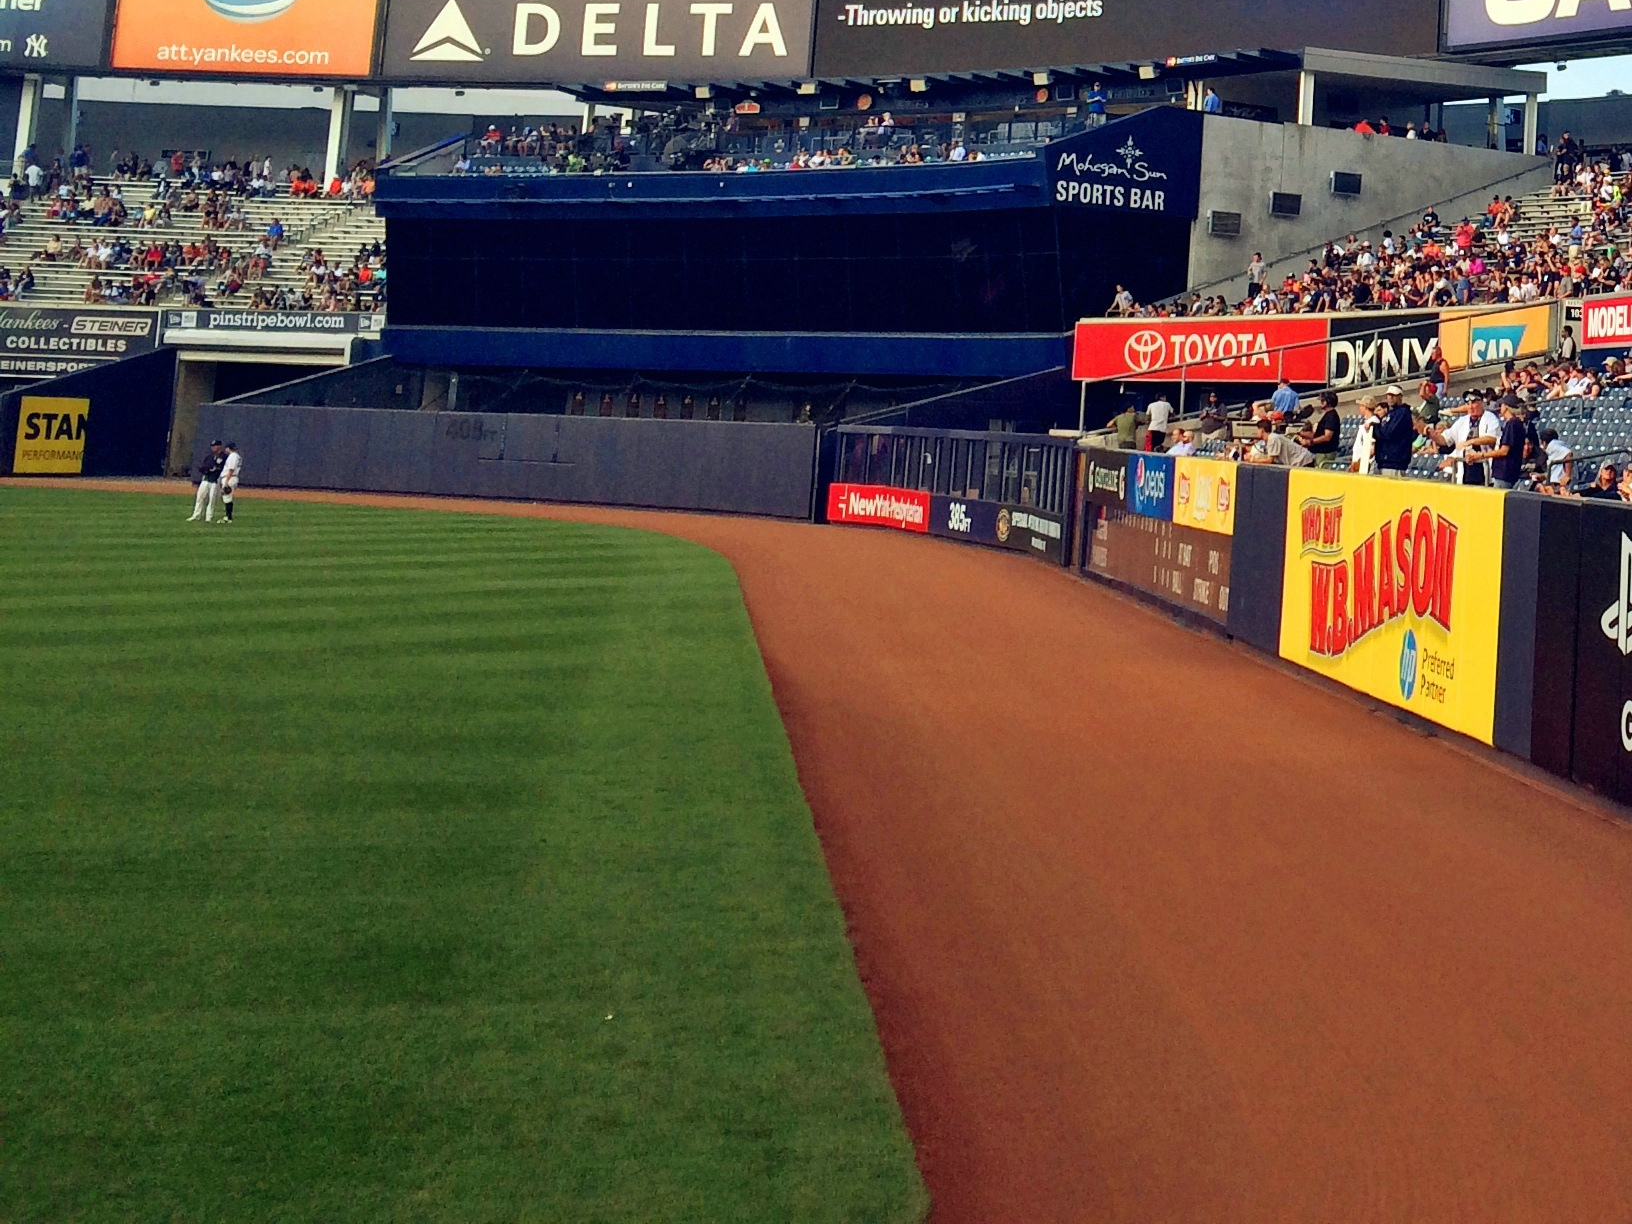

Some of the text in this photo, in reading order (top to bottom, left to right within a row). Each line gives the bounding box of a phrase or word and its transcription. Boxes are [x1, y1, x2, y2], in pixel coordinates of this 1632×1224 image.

[512, 3, 788, 56] DELTA
[837, 3, 934, 29] -Throwing
[939, 6, 959, 24] or
[962, 0, 1032, 25] kicking
[156, 43, 329, 68] att.yankees.com
[1056, 152, 1167, 181] Mohegan Sun
[1055, 180, 1165, 211] SPORTS BAR
[73, 318, 149, 333] STEINER
[208, 311, 344, 330] pinstripebowl.com
[6, 336, 127, 352] COLLECTIBLES
[1170, 332, 1270, 367] TOYOTA
[1330, 338, 1439, 386] DKNY
[1144, 464, 1166, 506] pepsi
[1302, 505, 1343, 546] WHO BUT
[1421, 647, 1455, 680] Preferred
[1420, 674, 1446, 704] Partner
